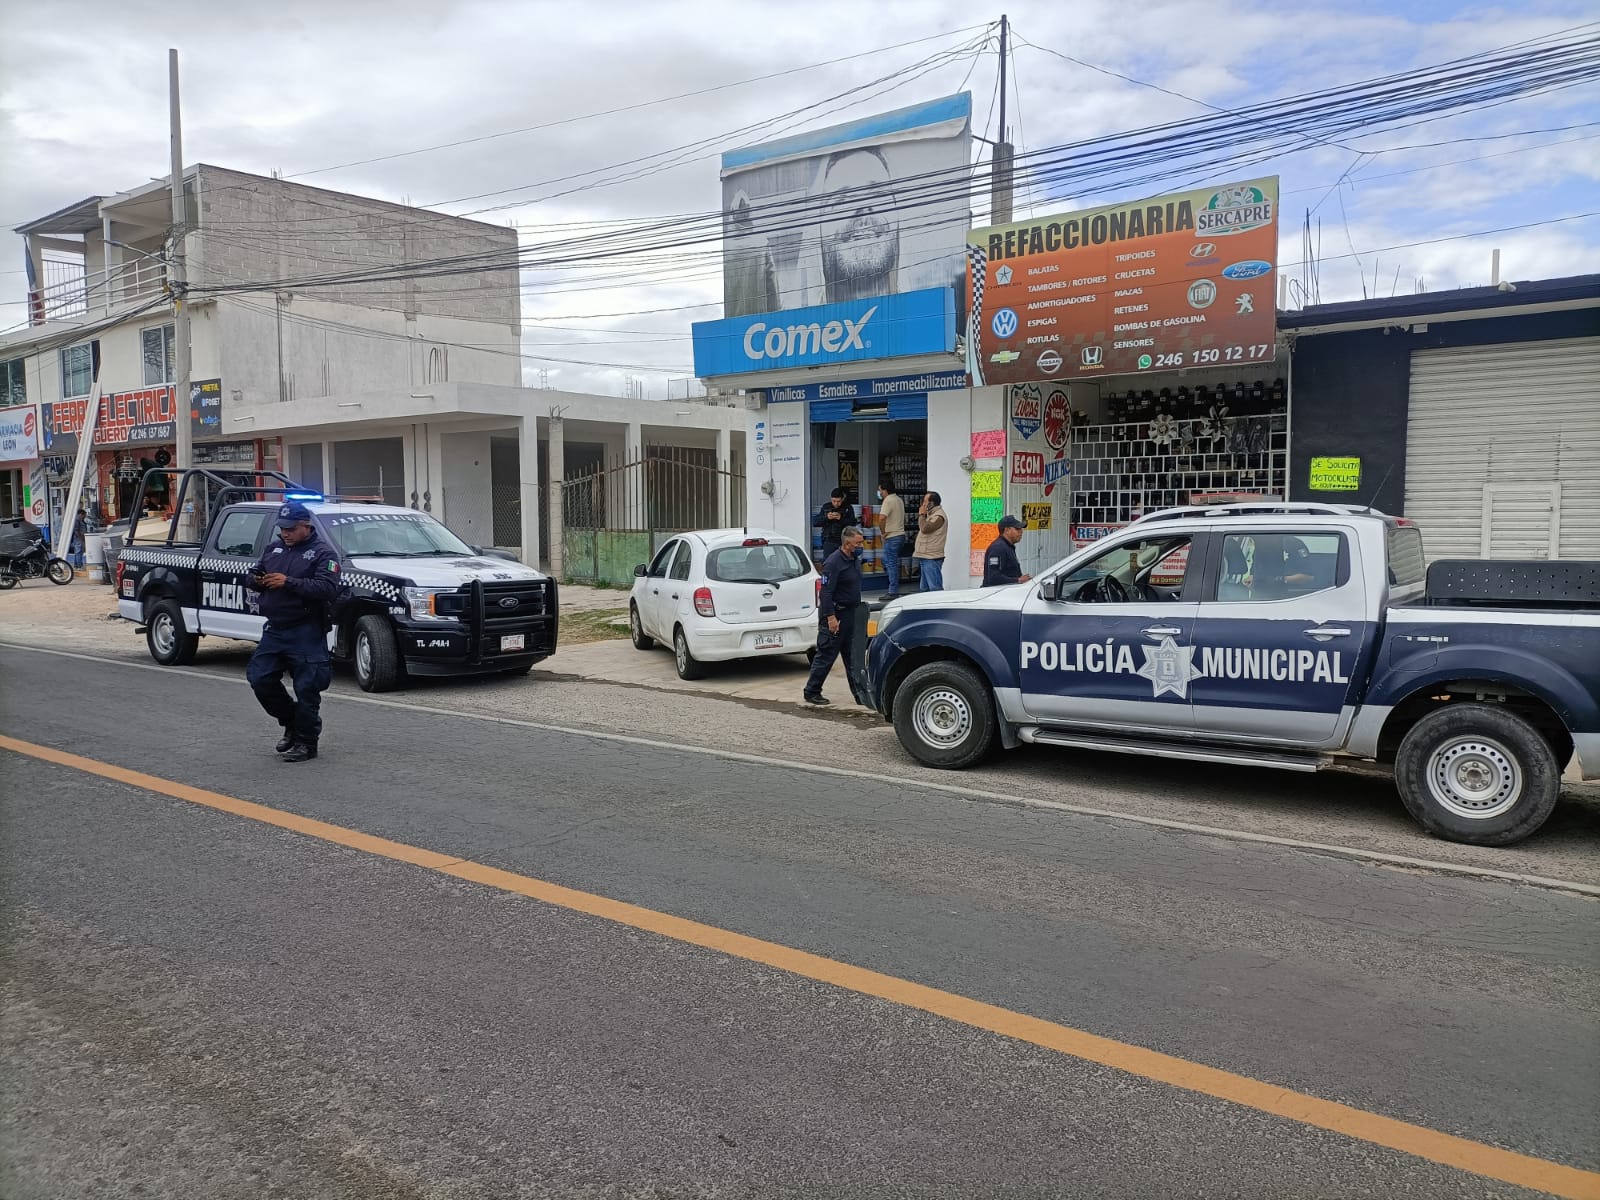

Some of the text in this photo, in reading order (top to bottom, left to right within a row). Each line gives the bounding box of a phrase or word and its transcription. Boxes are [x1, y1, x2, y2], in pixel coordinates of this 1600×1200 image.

[1198, 203, 1271, 231] SERCAPRE
[988, 199, 1194, 262] REFACCIONARIA
[1115, 249, 1156, 263] TRIPOIDES
[1028, 264, 1060, 276] BALATAS
[1114, 267, 1156, 280] CRUCETAS
[1028, 281, 1067, 293] TAMBORES
[1072, 275, 1107, 288] ROTORES
[1114, 287, 1143, 298] MAZAS
[1194, 286, 1210, 301] FIAT
[1027, 294, 1097, 310] AMORTIGUADORES
[1114, 303, 1149, 315] RETENES
[1027, 317, 1057, 328] ESPIGAS
[1113, 314, 1206, 333] BOMBAS DE GASOLINA
[743, 305, 879, 360] Comex
[1027, 334, 1060, 345] ROTULAS
[1113, 338, 1155, 350] SENSORES
[1154, 344, 1269, 368] 246 150 12 17
[819, 383, 858, 398] Esmaltes
[872, 374, 967, 393] Impermeabilizantes
[1014, 400, 1040, 417] LUCAS
[202, 577, 244, 610] POLICÍA
[1021, 639, 1348, 684] POLICÍA MUNICIPAL
